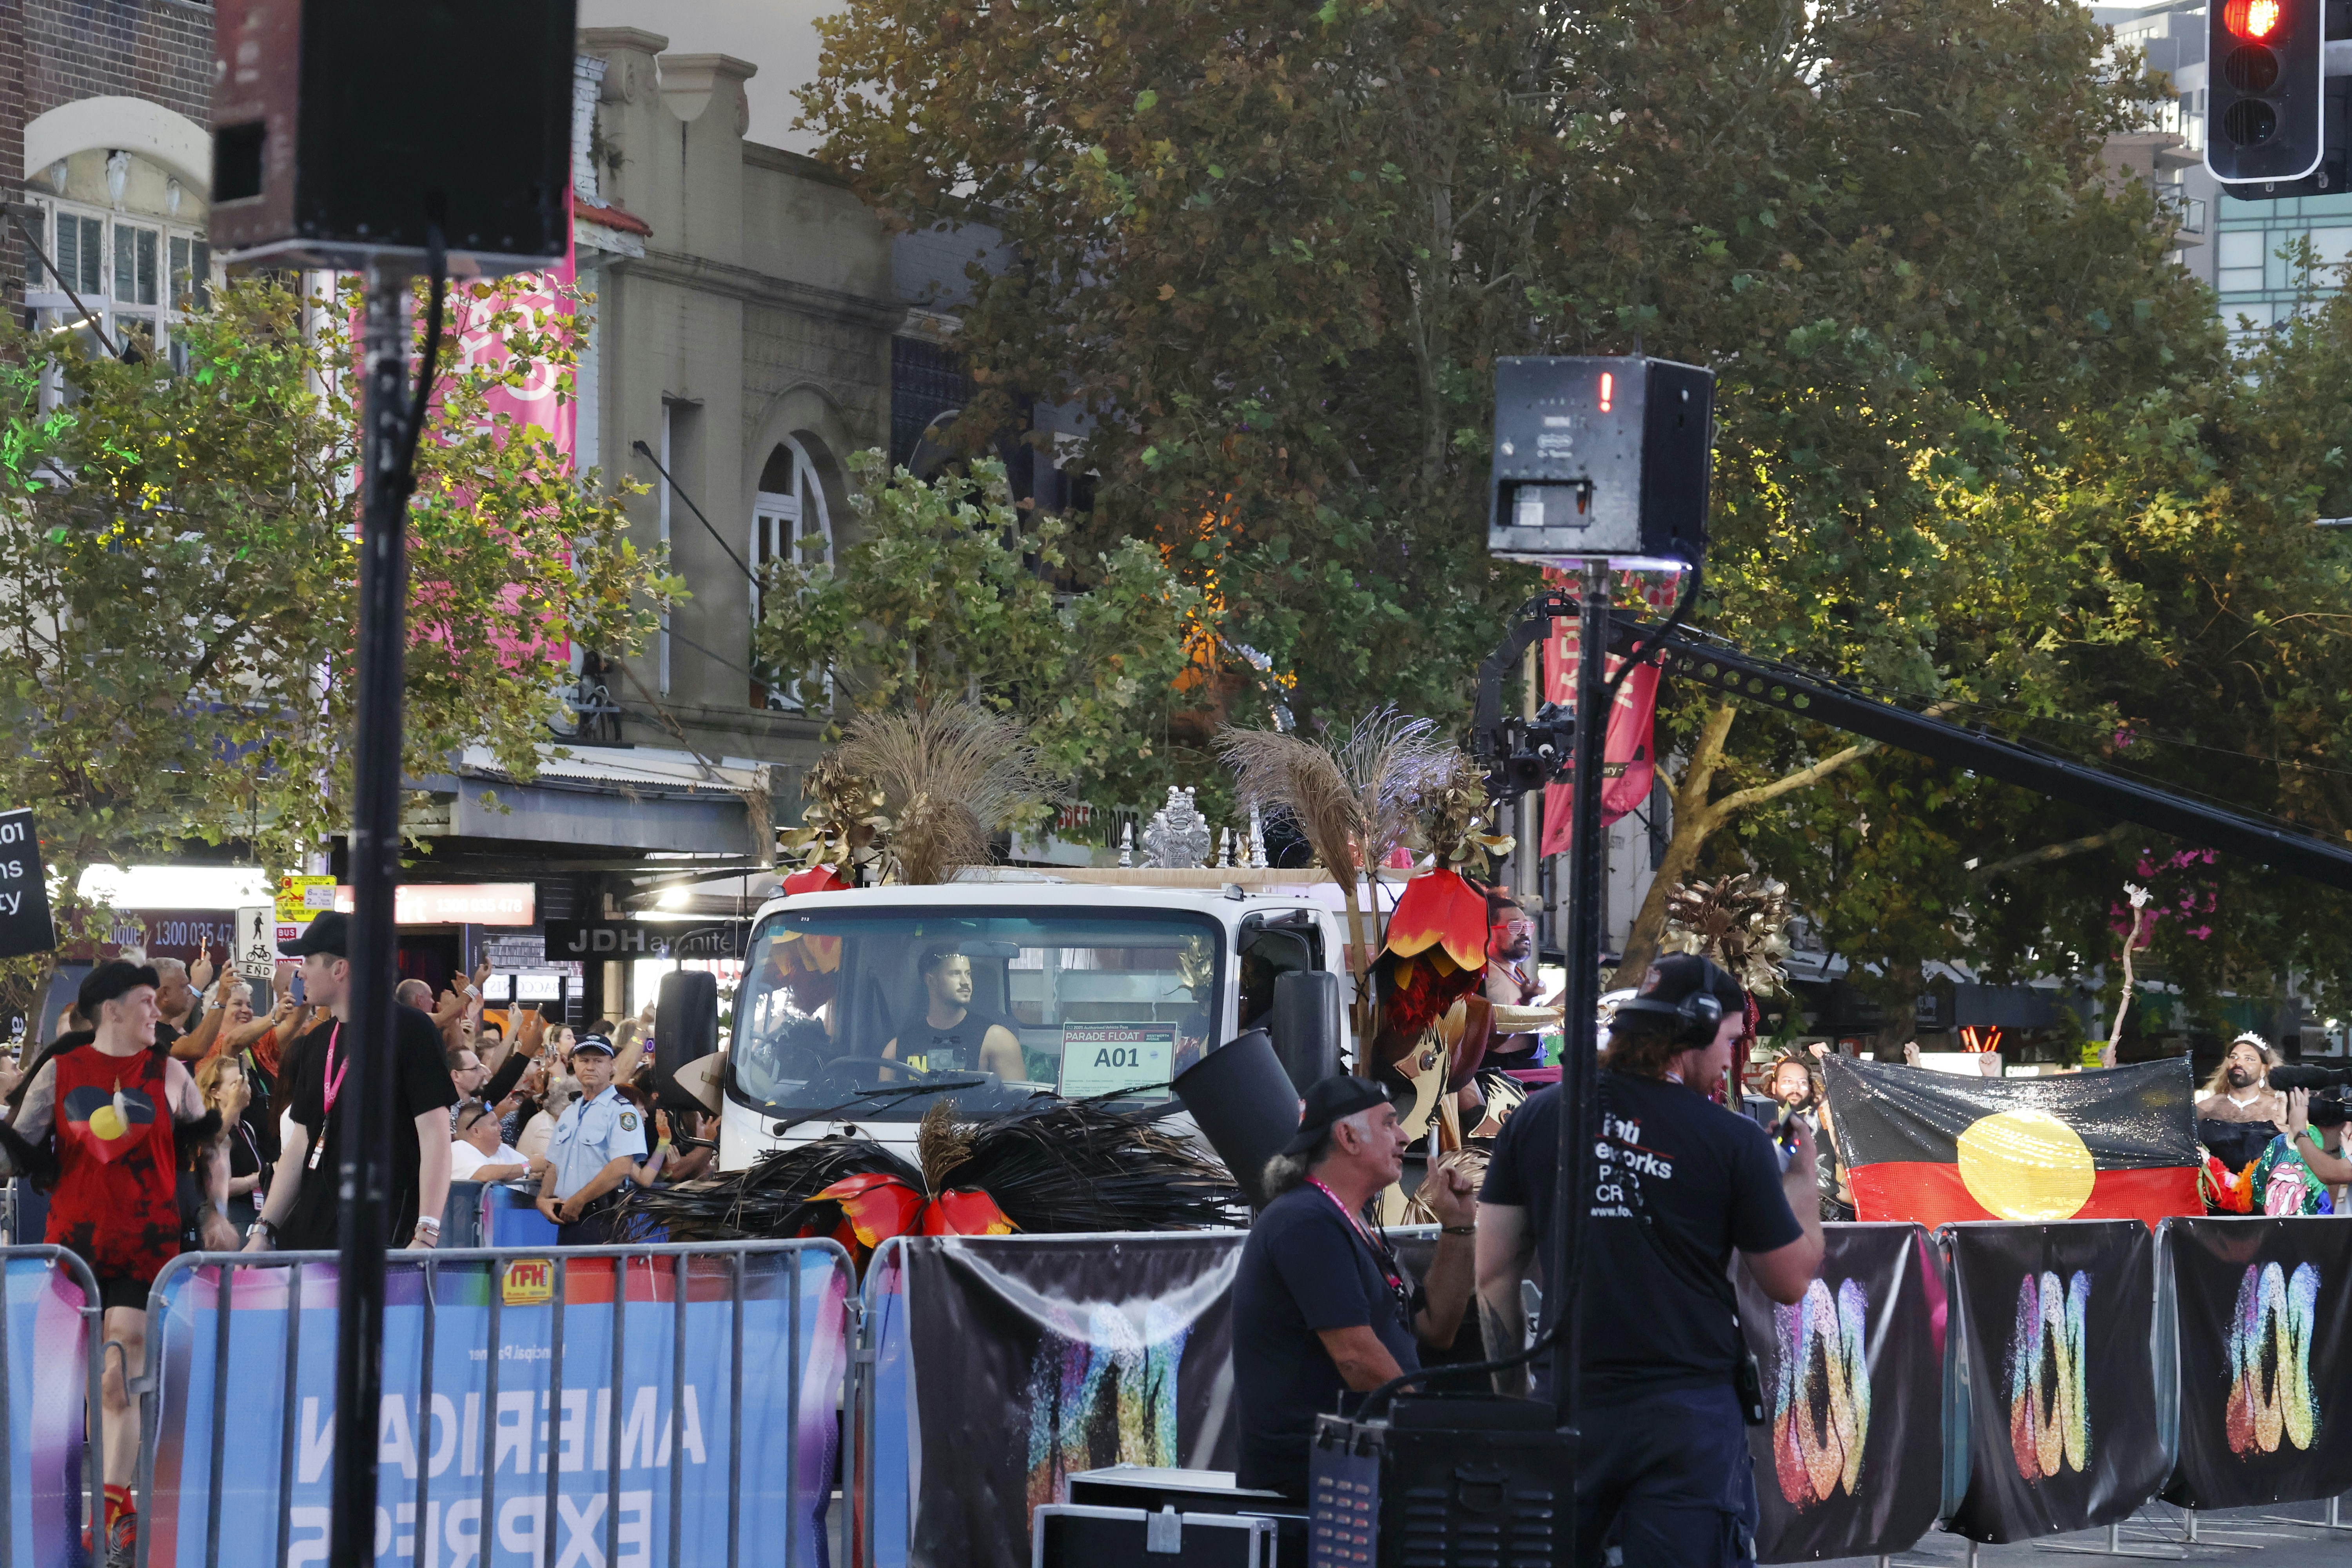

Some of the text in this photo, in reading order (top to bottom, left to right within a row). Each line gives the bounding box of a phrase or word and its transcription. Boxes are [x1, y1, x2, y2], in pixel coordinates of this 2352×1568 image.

[0, 822, 24, 844] 01
[0, 860, 24, 879] ns
[497, 899, 523, 912] 478
[156, 921, 187, 946] 1300
[189, 922, 214, 947] 035
[569, 929, 732, 952] JDH arhite
[246, 965, 270, 976] END
[1065, 1032, 1140, 1041] PARADE FLOAT
[1094, 1048, 1139, 1067] A01
